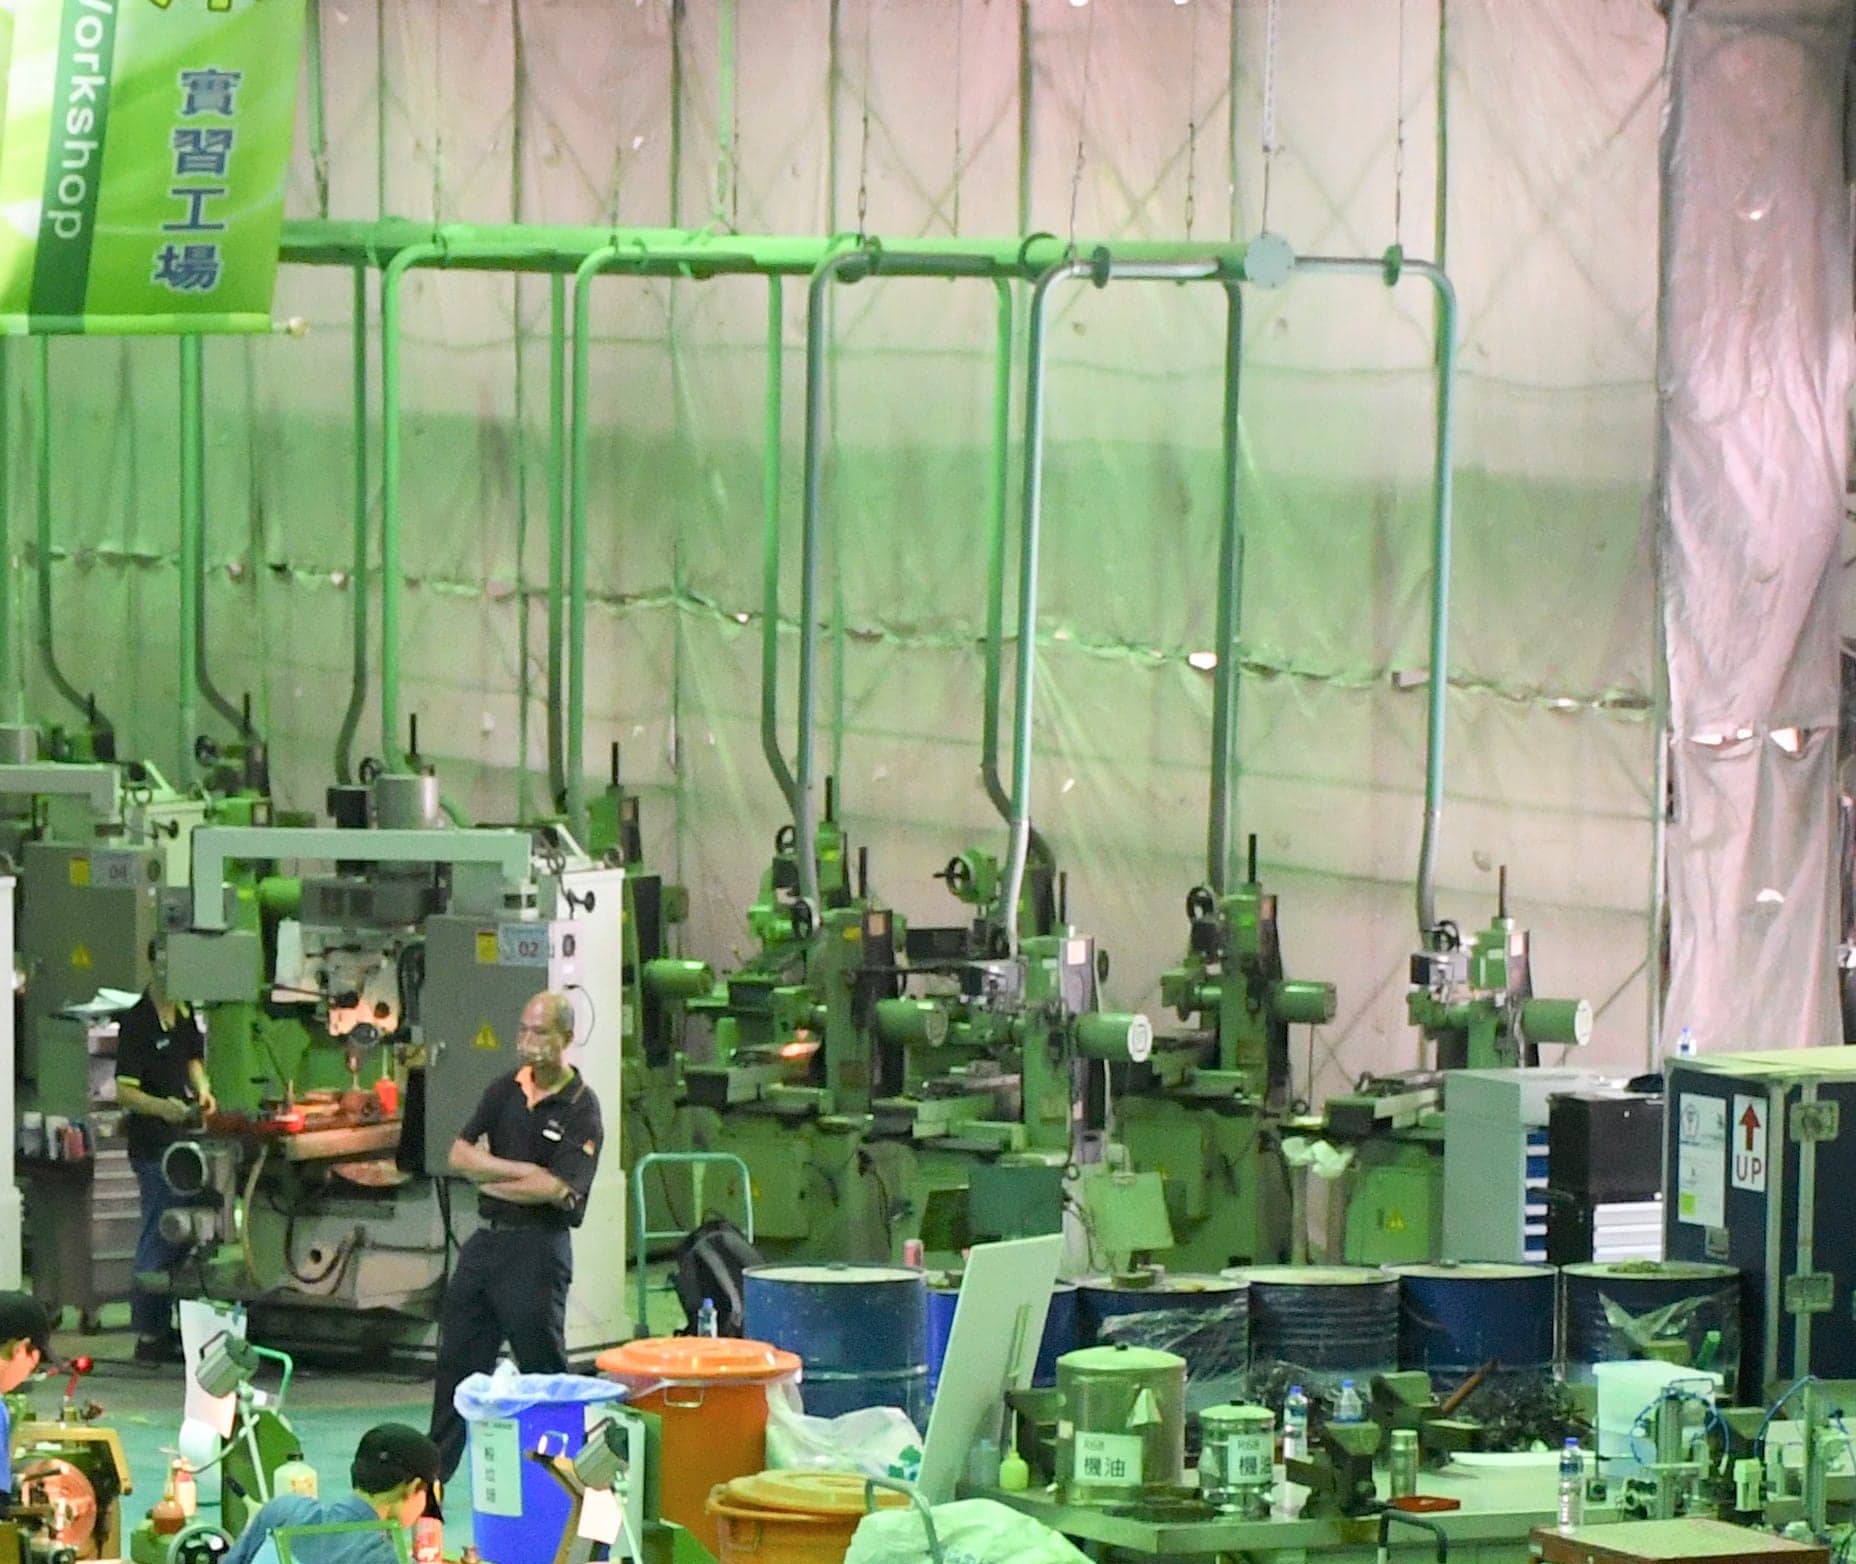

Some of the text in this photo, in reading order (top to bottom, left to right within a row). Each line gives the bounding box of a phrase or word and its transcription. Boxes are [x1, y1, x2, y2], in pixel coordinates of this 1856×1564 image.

[153, 68, 242, 290] 實習工場
[518, 942, 538, 957] 02
[1736, 1155, 1762, 1185] UP
[1084, 1457, 1126, 1478] 機油
